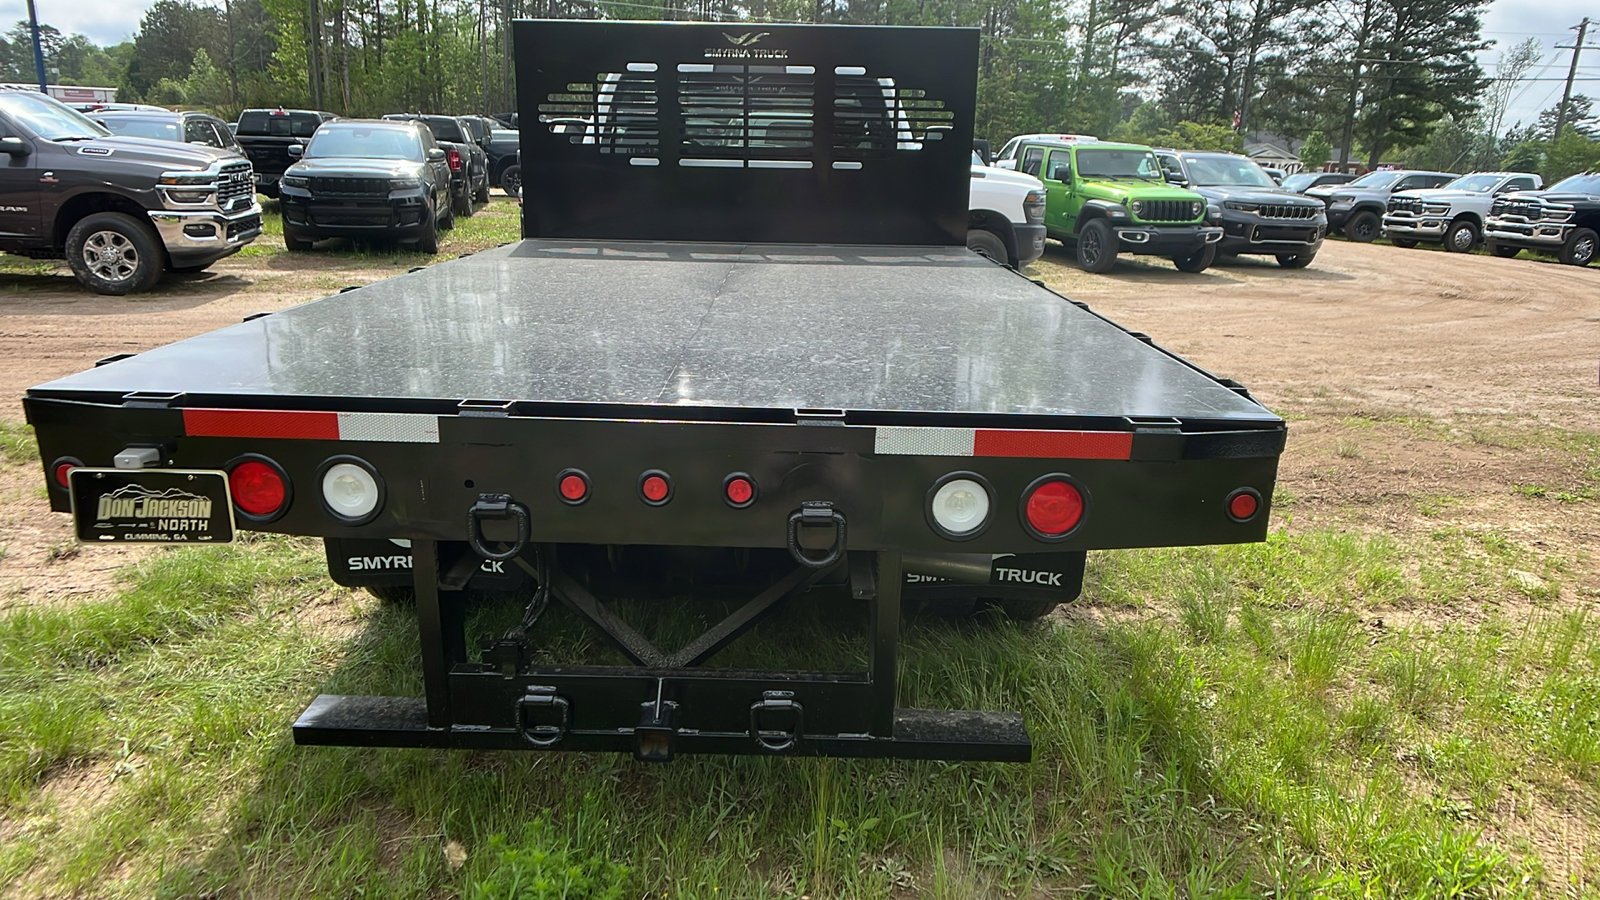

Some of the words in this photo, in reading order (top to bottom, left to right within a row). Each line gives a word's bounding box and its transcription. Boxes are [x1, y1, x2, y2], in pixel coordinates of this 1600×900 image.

[704, 48, 751, 58] SMYRNA
[753, 49, 788, 58] TRUCK
[97, 497, 135, 520] DON
[135, 497, 212, 519] JACKSON
[158, 519, 208, 531] NORTH
[124, 533, 171, 541] CUMMING,
[348, 556, 413, 570] SMYR
[996, 567, 1063, 586] TRUCK
